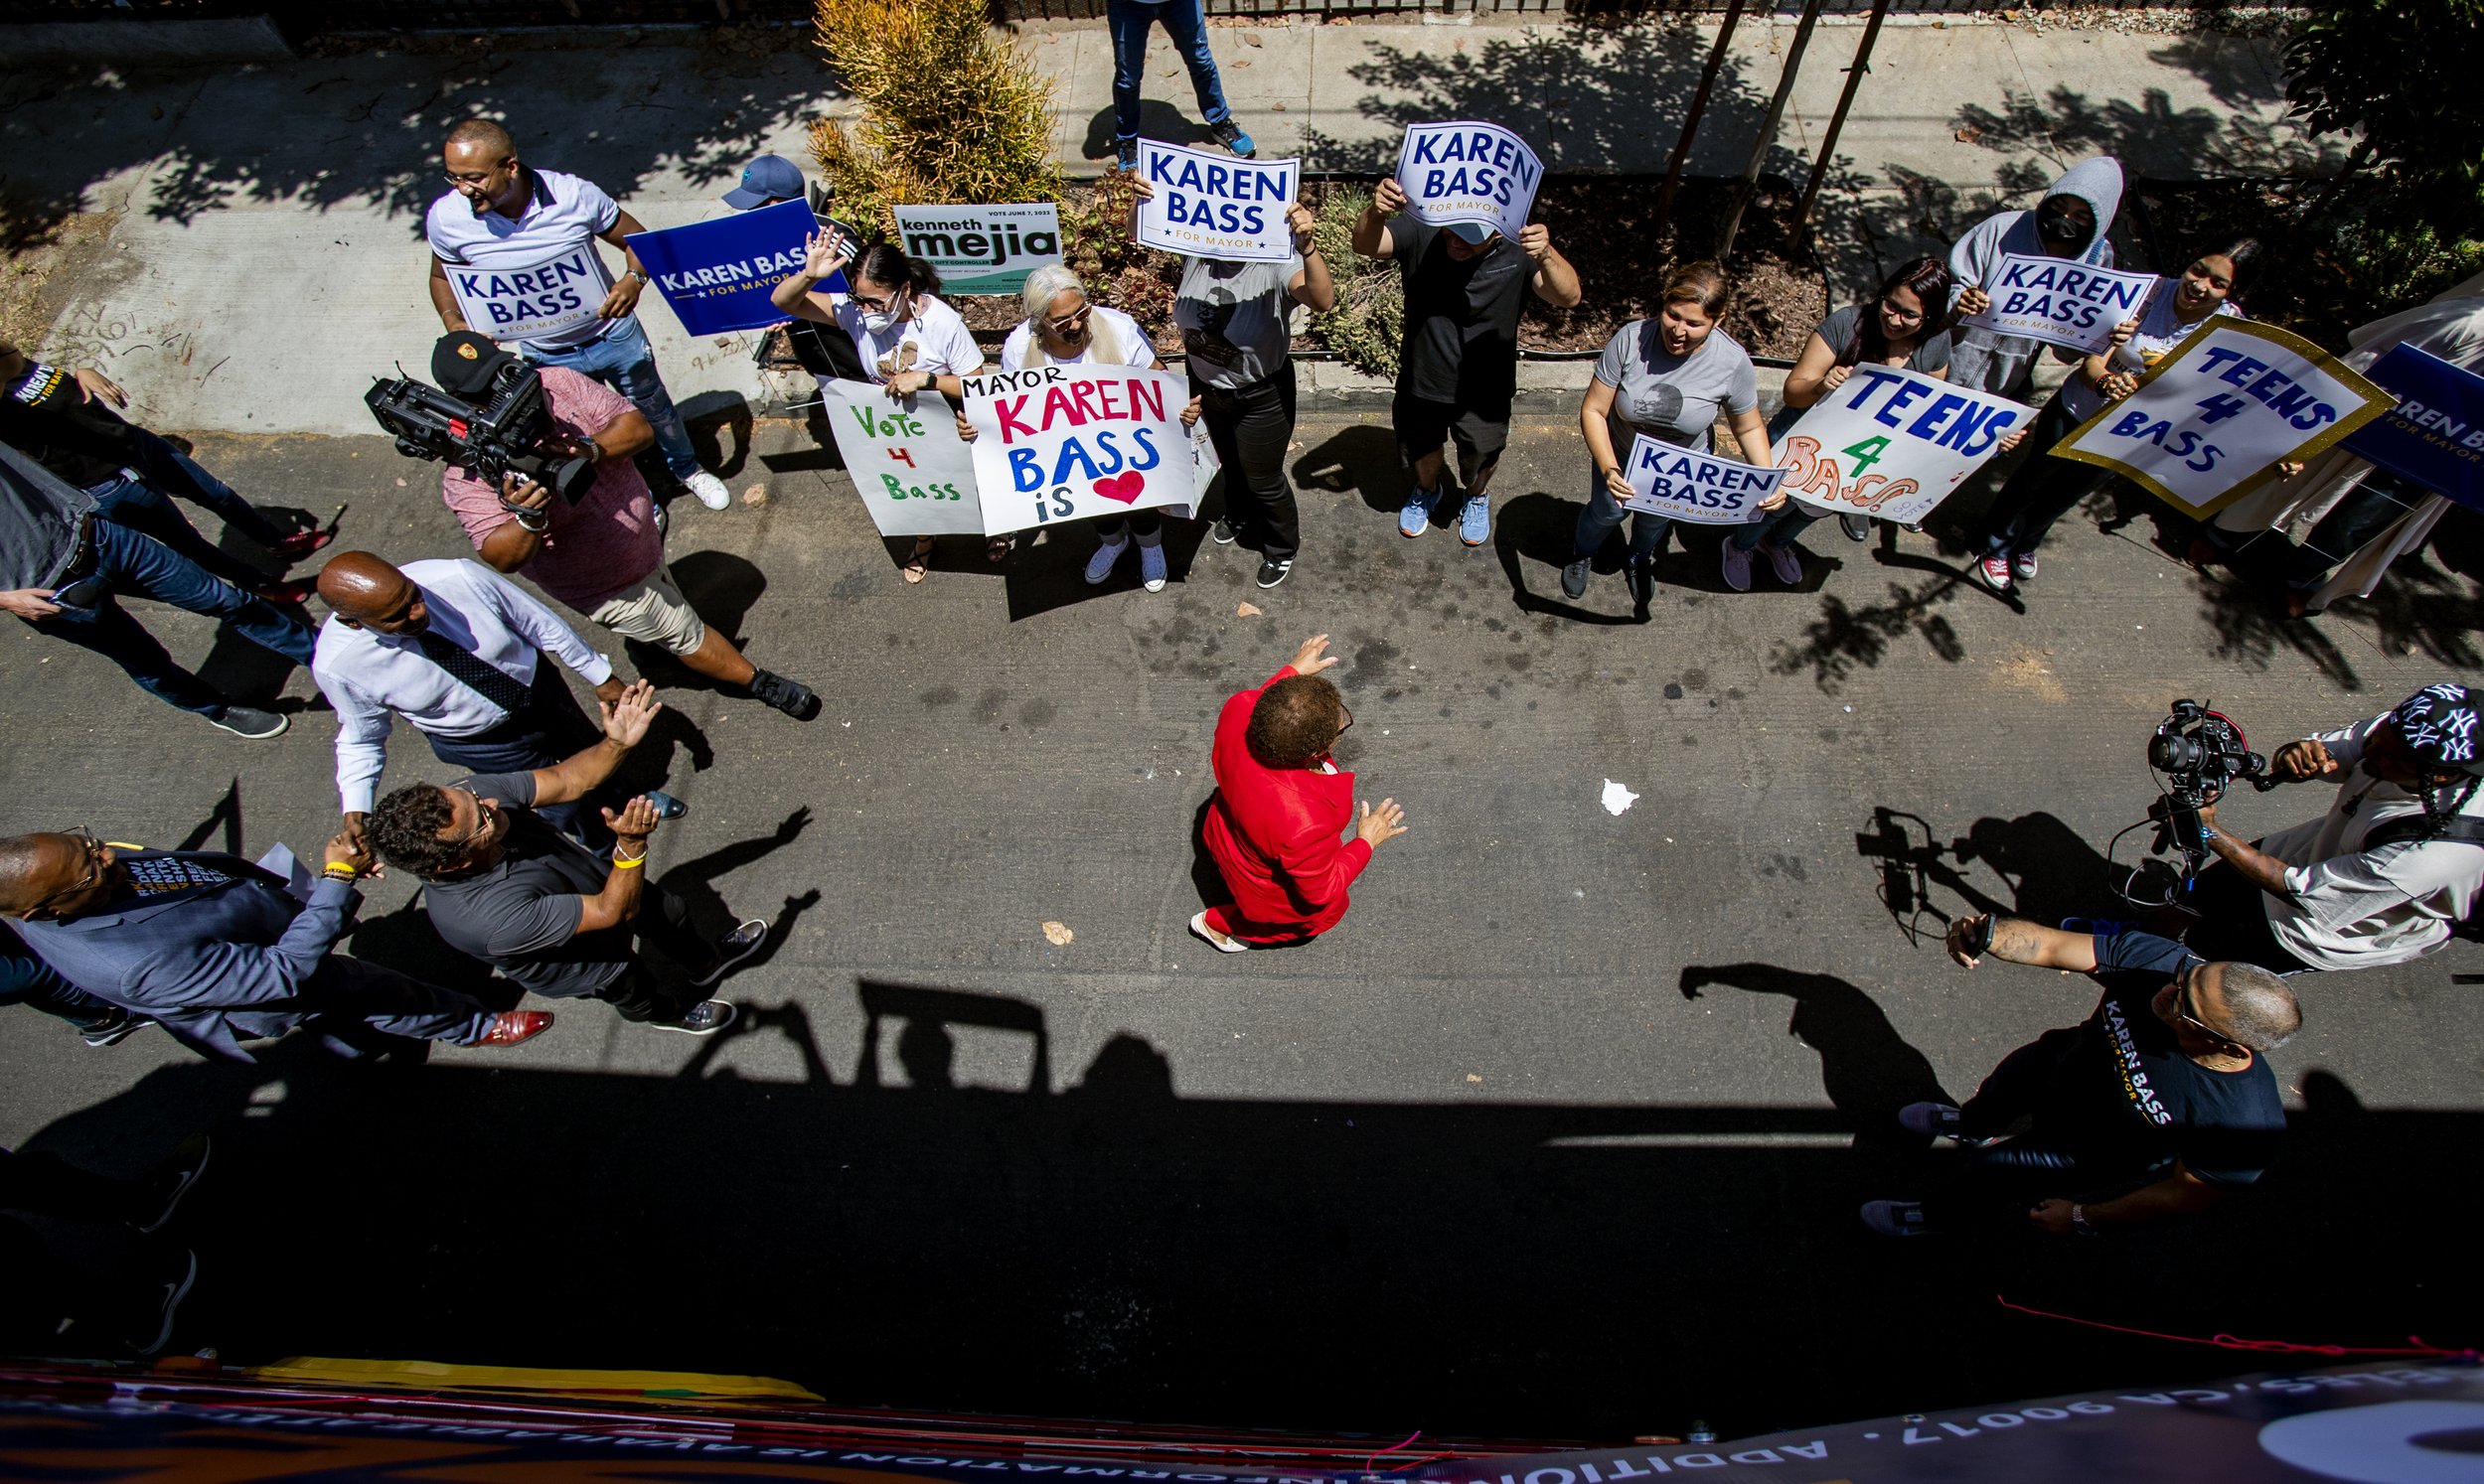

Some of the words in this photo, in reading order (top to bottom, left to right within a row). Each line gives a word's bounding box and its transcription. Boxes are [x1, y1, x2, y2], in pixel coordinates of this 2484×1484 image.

[1151, 151, 1287, 202] KAREN
[1413, 132, 1535, 193] KAREN
[1423, 167, 1514, 207] BASS
[901, 219, 983, 230] kenneth
[1167, 191, 1264, 234] BASS
[1429, 202, 1452, 213] FOR
[1456, 202, 1499, 216] MAYOR
[906, 223, 1058, 266] mejia
[1175, 229, 1200, 242] FOR
[1205, 235, 1253, 248] MAYOR
[457, 254, 587, 298] KAREN
[660, 260, 753, 291] KAREN
[753, 246, 808, 275] BAS
[2001, 263, 2142, 311] KAREN
[486, 287, 581, 324] BASS
[708, 285, 737, 297] FOR
[509, 324, 534, 334] FOR
[538, 313, 579, 329] MAYOR
[2001, 292, 2103, 329] BASS
[2002, 318, 2028, 328] FOR
[2032, 321, 2076, 338] MAYOR
[15, 370, 51, 402] KAREN
[42, 383, 57, 397] FOR
[961, 367, 1068, 397] MAYOR
[2197, 347, 2336, 430] TEENS
[994, 378, 1166, 444] KAREN
[1846, 370, 2017, 457] TEENS
[2195, 392, 2246, 425] 4
[886, 448, 917, 468] 4
[1840, 435, 1892, 478] 4
[2108, 410, 2226, 473] BASS
[2386, 415, 2419, 434] FOR
[2422, 432, 2481, 463] MAYOR
[1008, 427, 1161, 493] BASS
[1640, 446, 1776, 492] KAREN
[879, 473, 962, 502] Bass
[1649, 476, 1746, 510] BASS
[1656, 500, 1680, 511] FOR
[1684, 508, 1729, 518] MAYOR
[1893, 502, 1912, 513] GO
[2106, 1000, 2140, 1070] KAREN
[2131, 1072, 2172, 1125] BASS
[2114, 1387, 2232, 1405] CA
[1902, 1401, 2115, 1445] 90017
[758, 1446, 830, 1458] IS
[1459, 1439, 1828, 1484] ADDITIO
